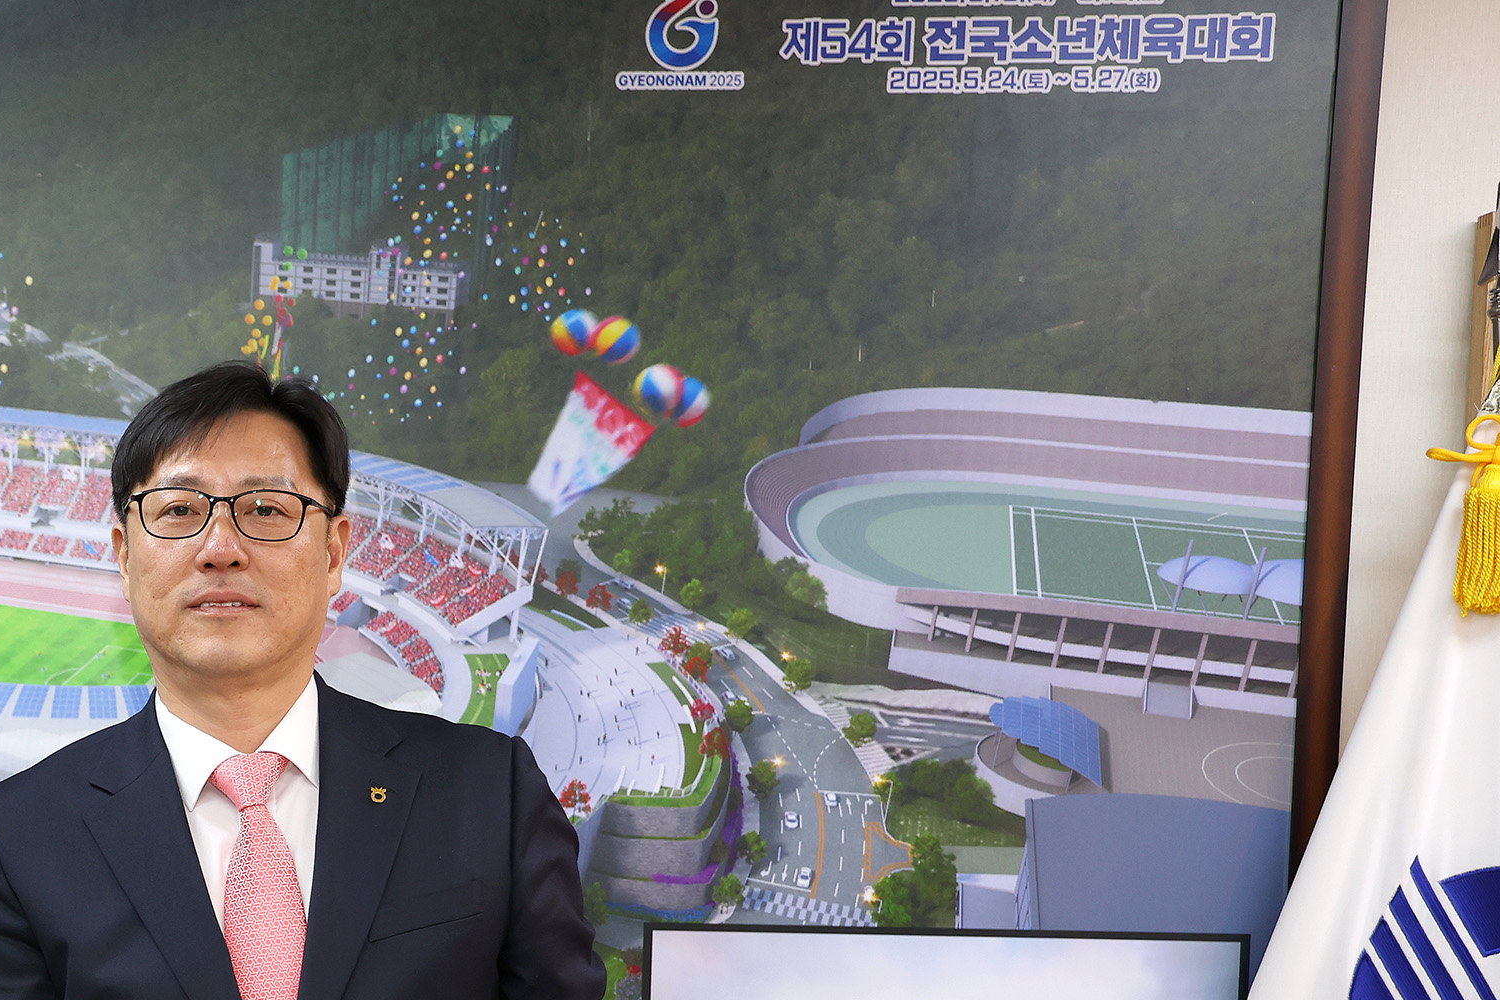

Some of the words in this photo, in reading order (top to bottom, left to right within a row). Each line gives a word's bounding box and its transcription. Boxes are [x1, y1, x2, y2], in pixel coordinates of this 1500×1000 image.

[784, 18, 912, 62] 제54회
[926, 15, 1274, 62] 전국소년체육대회
[618, 72, 707, 88] GYEONGNAM
[709, 72, 742, 88] 2025
